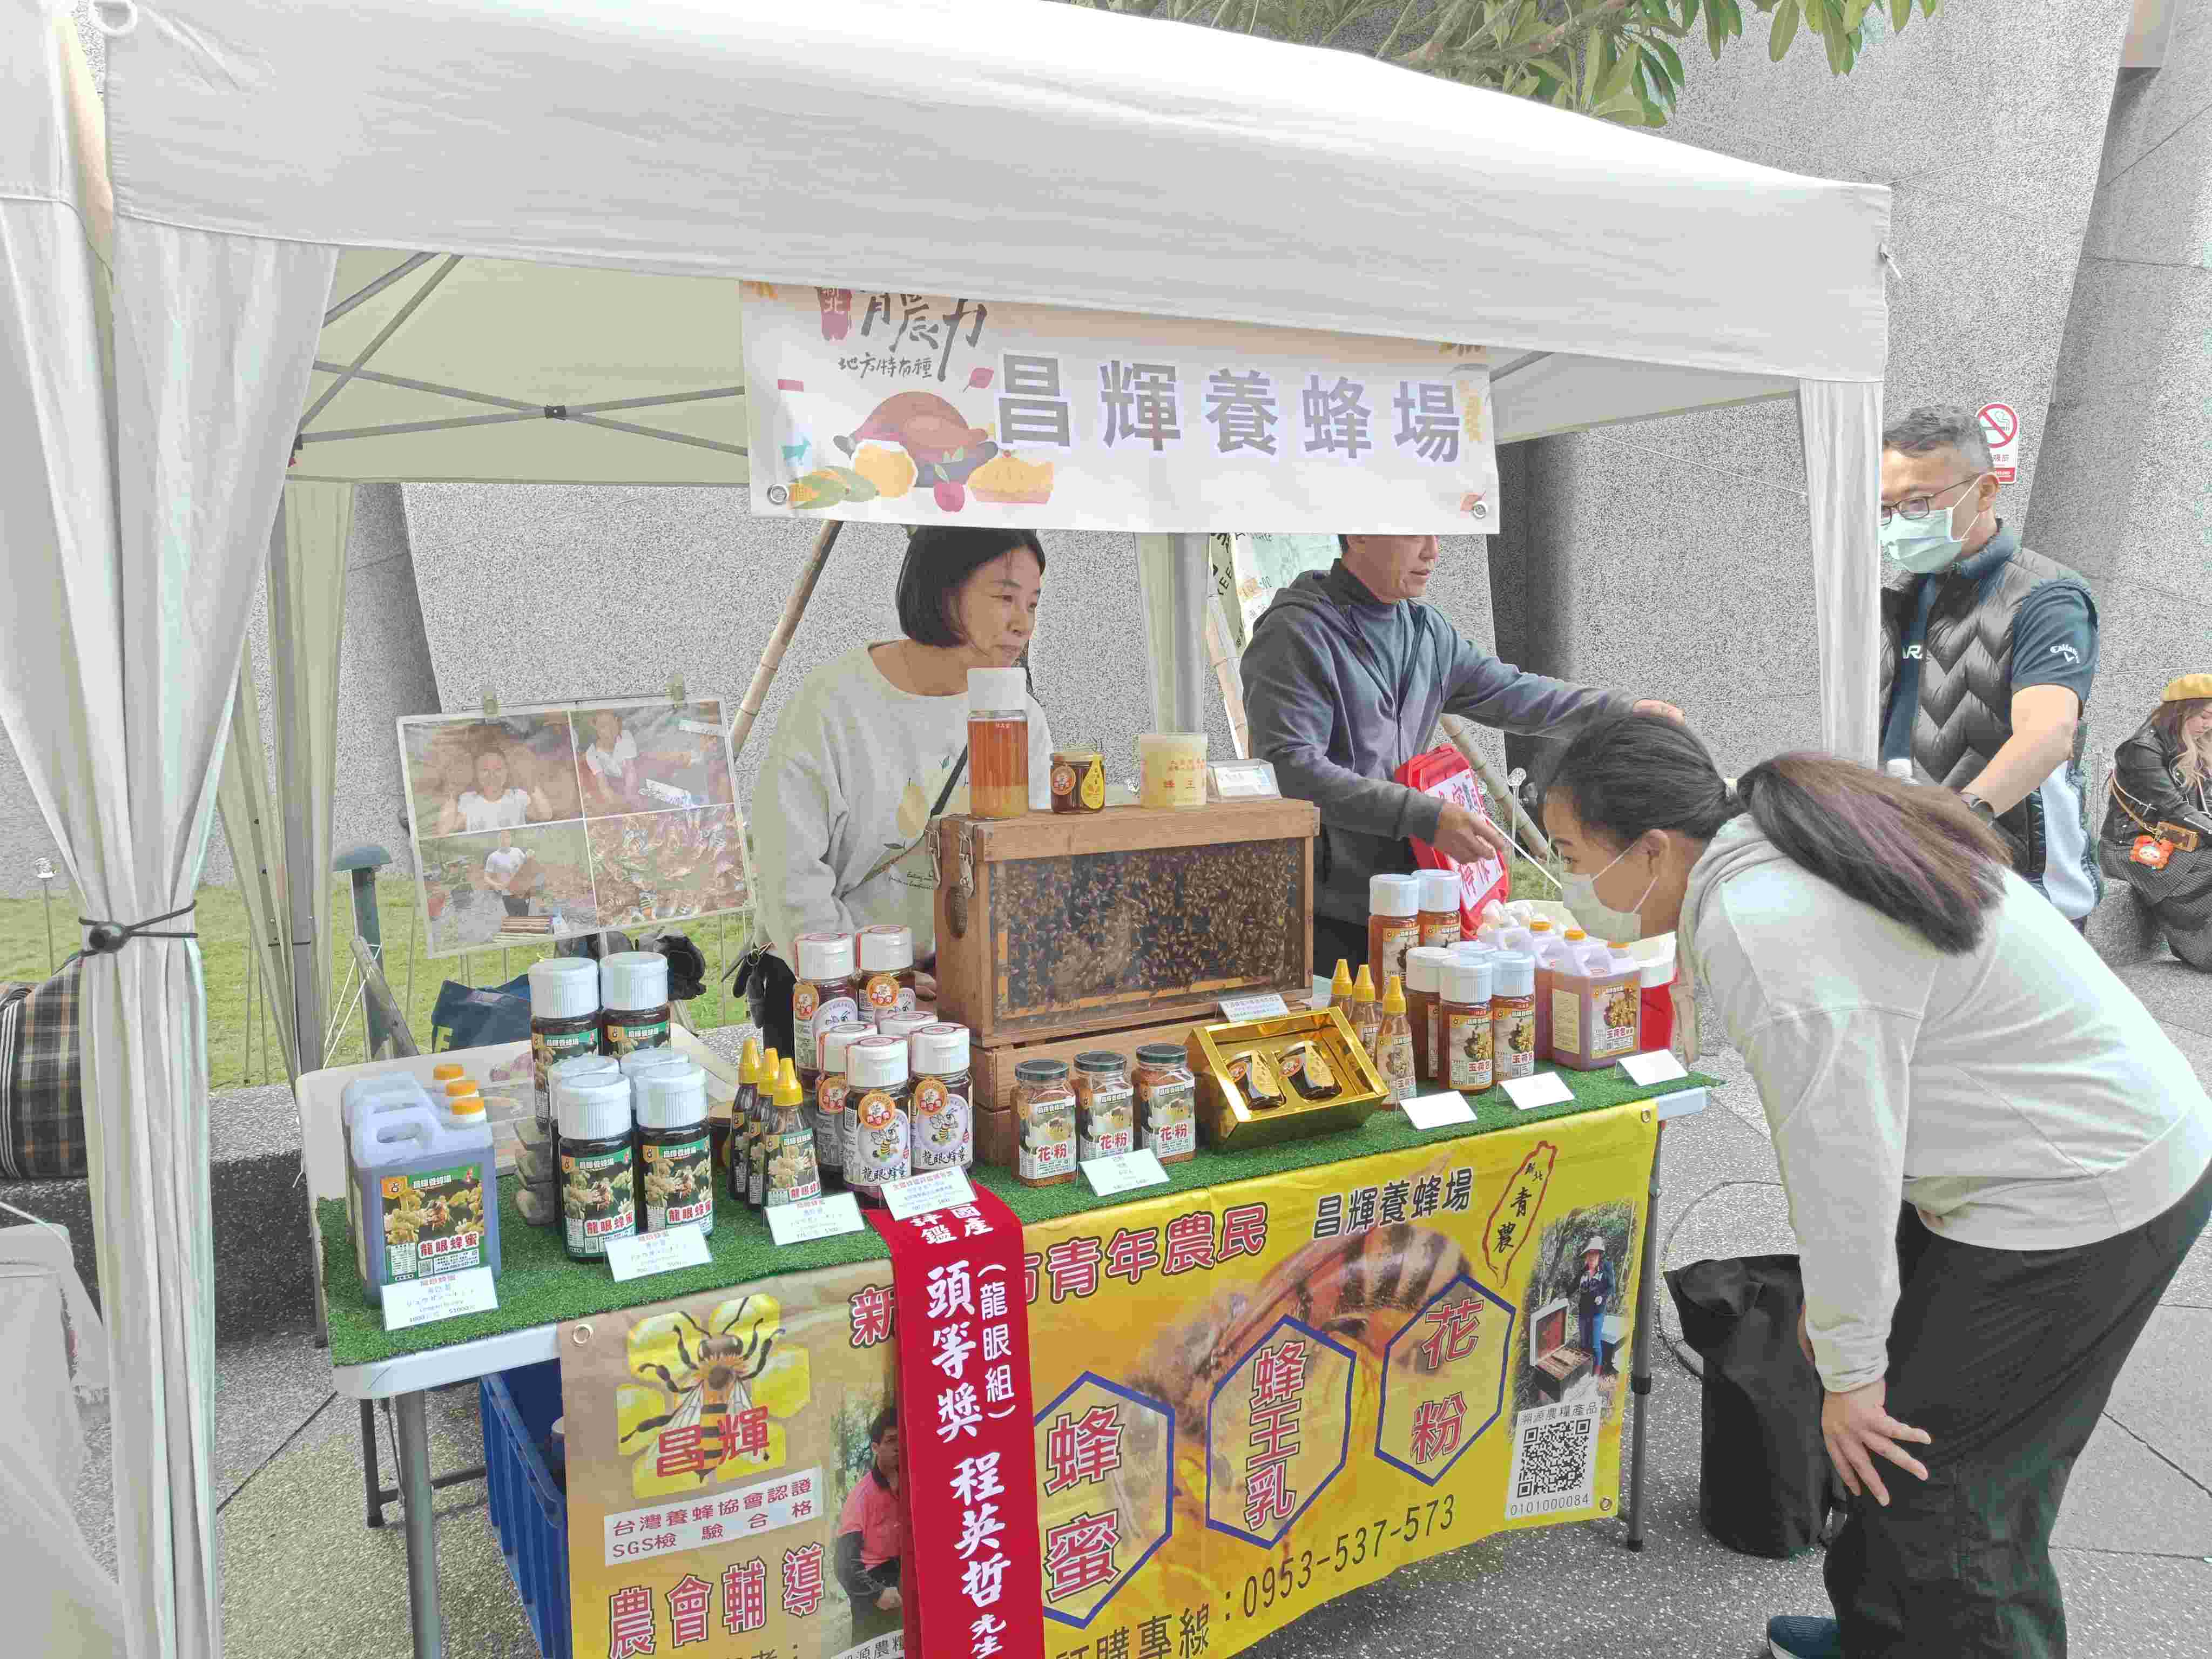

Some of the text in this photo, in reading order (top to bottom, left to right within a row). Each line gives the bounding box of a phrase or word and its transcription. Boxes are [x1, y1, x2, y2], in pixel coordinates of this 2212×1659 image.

[838, 352, 933, 379] 地方特有種
[999, 354, 1460, 463] 昌輝養蜂場
[1036, 1143, 1067, 1162] 花粉
[1099, 1132, 1128, 1150] 花粉
[1161, 1123, 1188, 1141] 花粉
[1313, 1168, 1473, 1239] 昌輝養蜂場
[419, 1232, 478, 1257] 龍眼蜂蜜
[1412, 1297, 1485, 1465] 花粉
[656, 1405, 770, 1478] 昌輝
[1243, 1338, 1310, 1532] 蜂王乳
[613, 1477, 812, 1537] 台灣養蜂協會認證
[1043, 1404, 1125, 1603] 蜂蜜
[1511, 1493, 1589, 1515] 0101000084
[1243, 1493, 1455, 1618] 0953-537-573
[609, 1541, 825, 1659] 農會輔導
